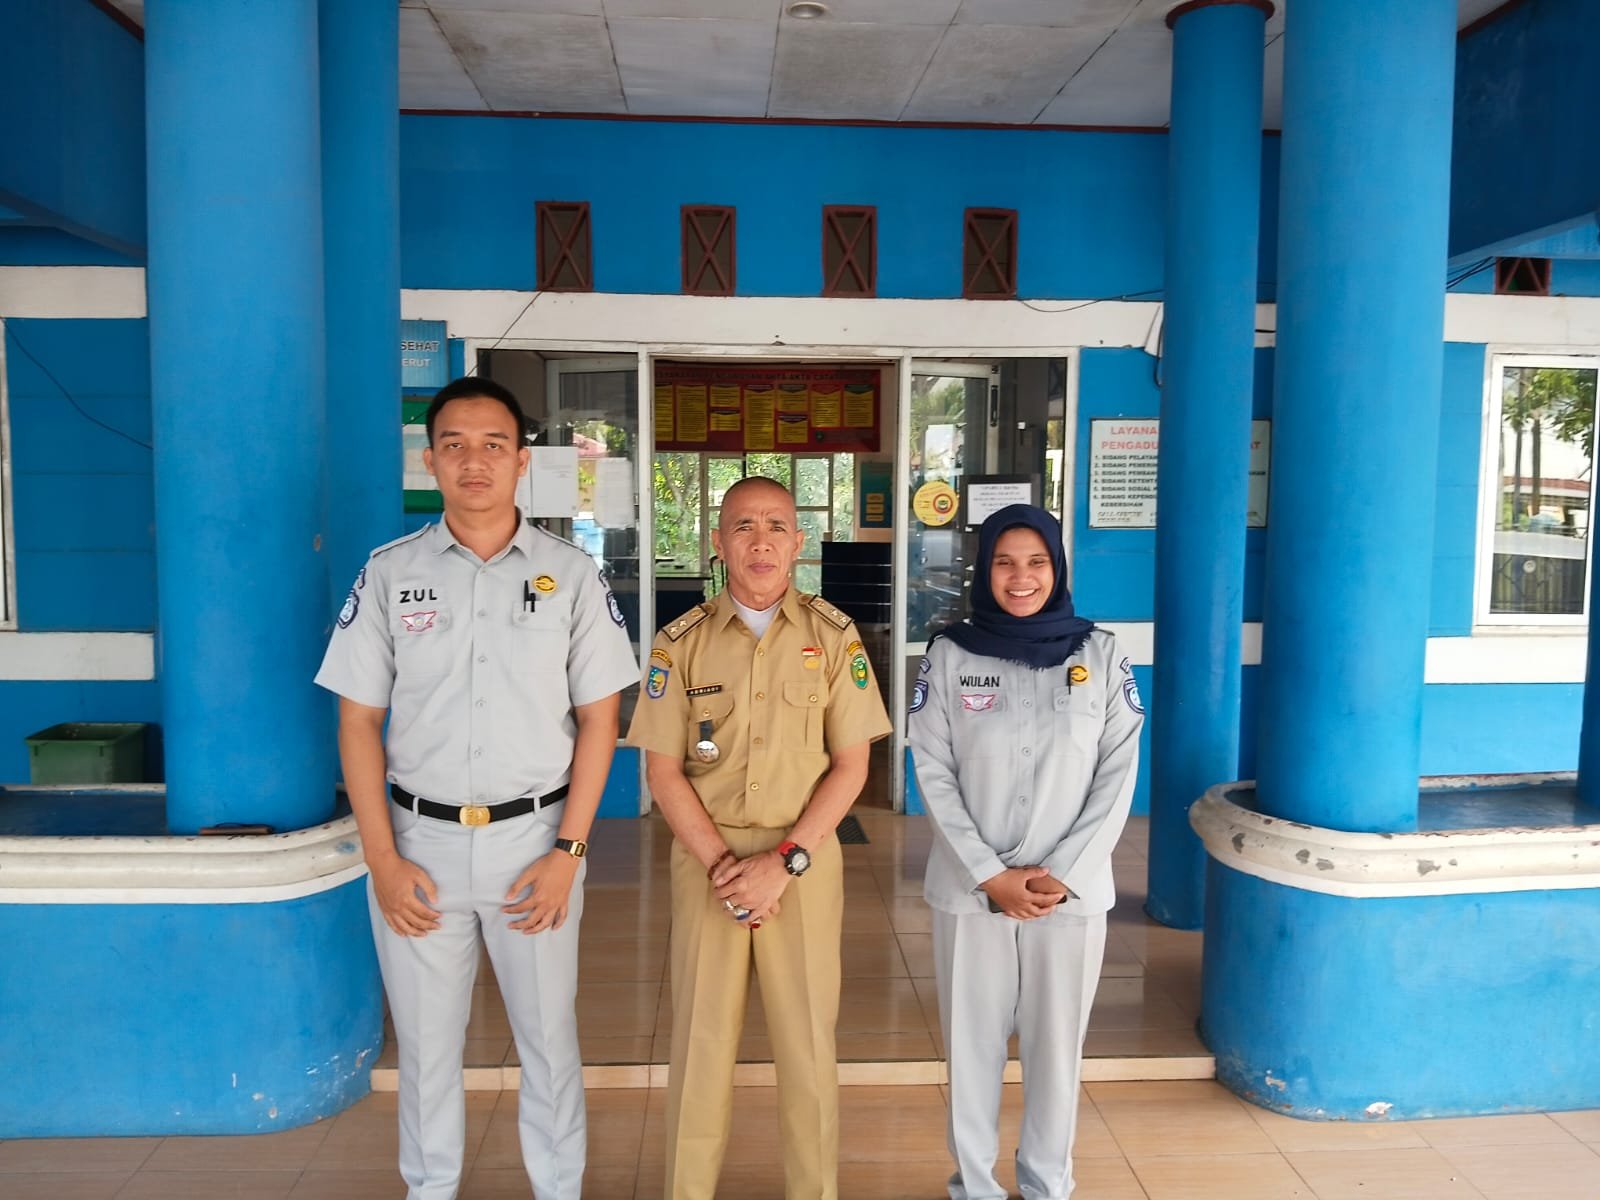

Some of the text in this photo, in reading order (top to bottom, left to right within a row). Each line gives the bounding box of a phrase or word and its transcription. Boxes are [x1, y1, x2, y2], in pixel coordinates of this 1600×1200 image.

[400, 341, 440, 352] SEHAT
[400, 588, 438, 604] ZUL
[959, 675, 1000, 688] WULAN
